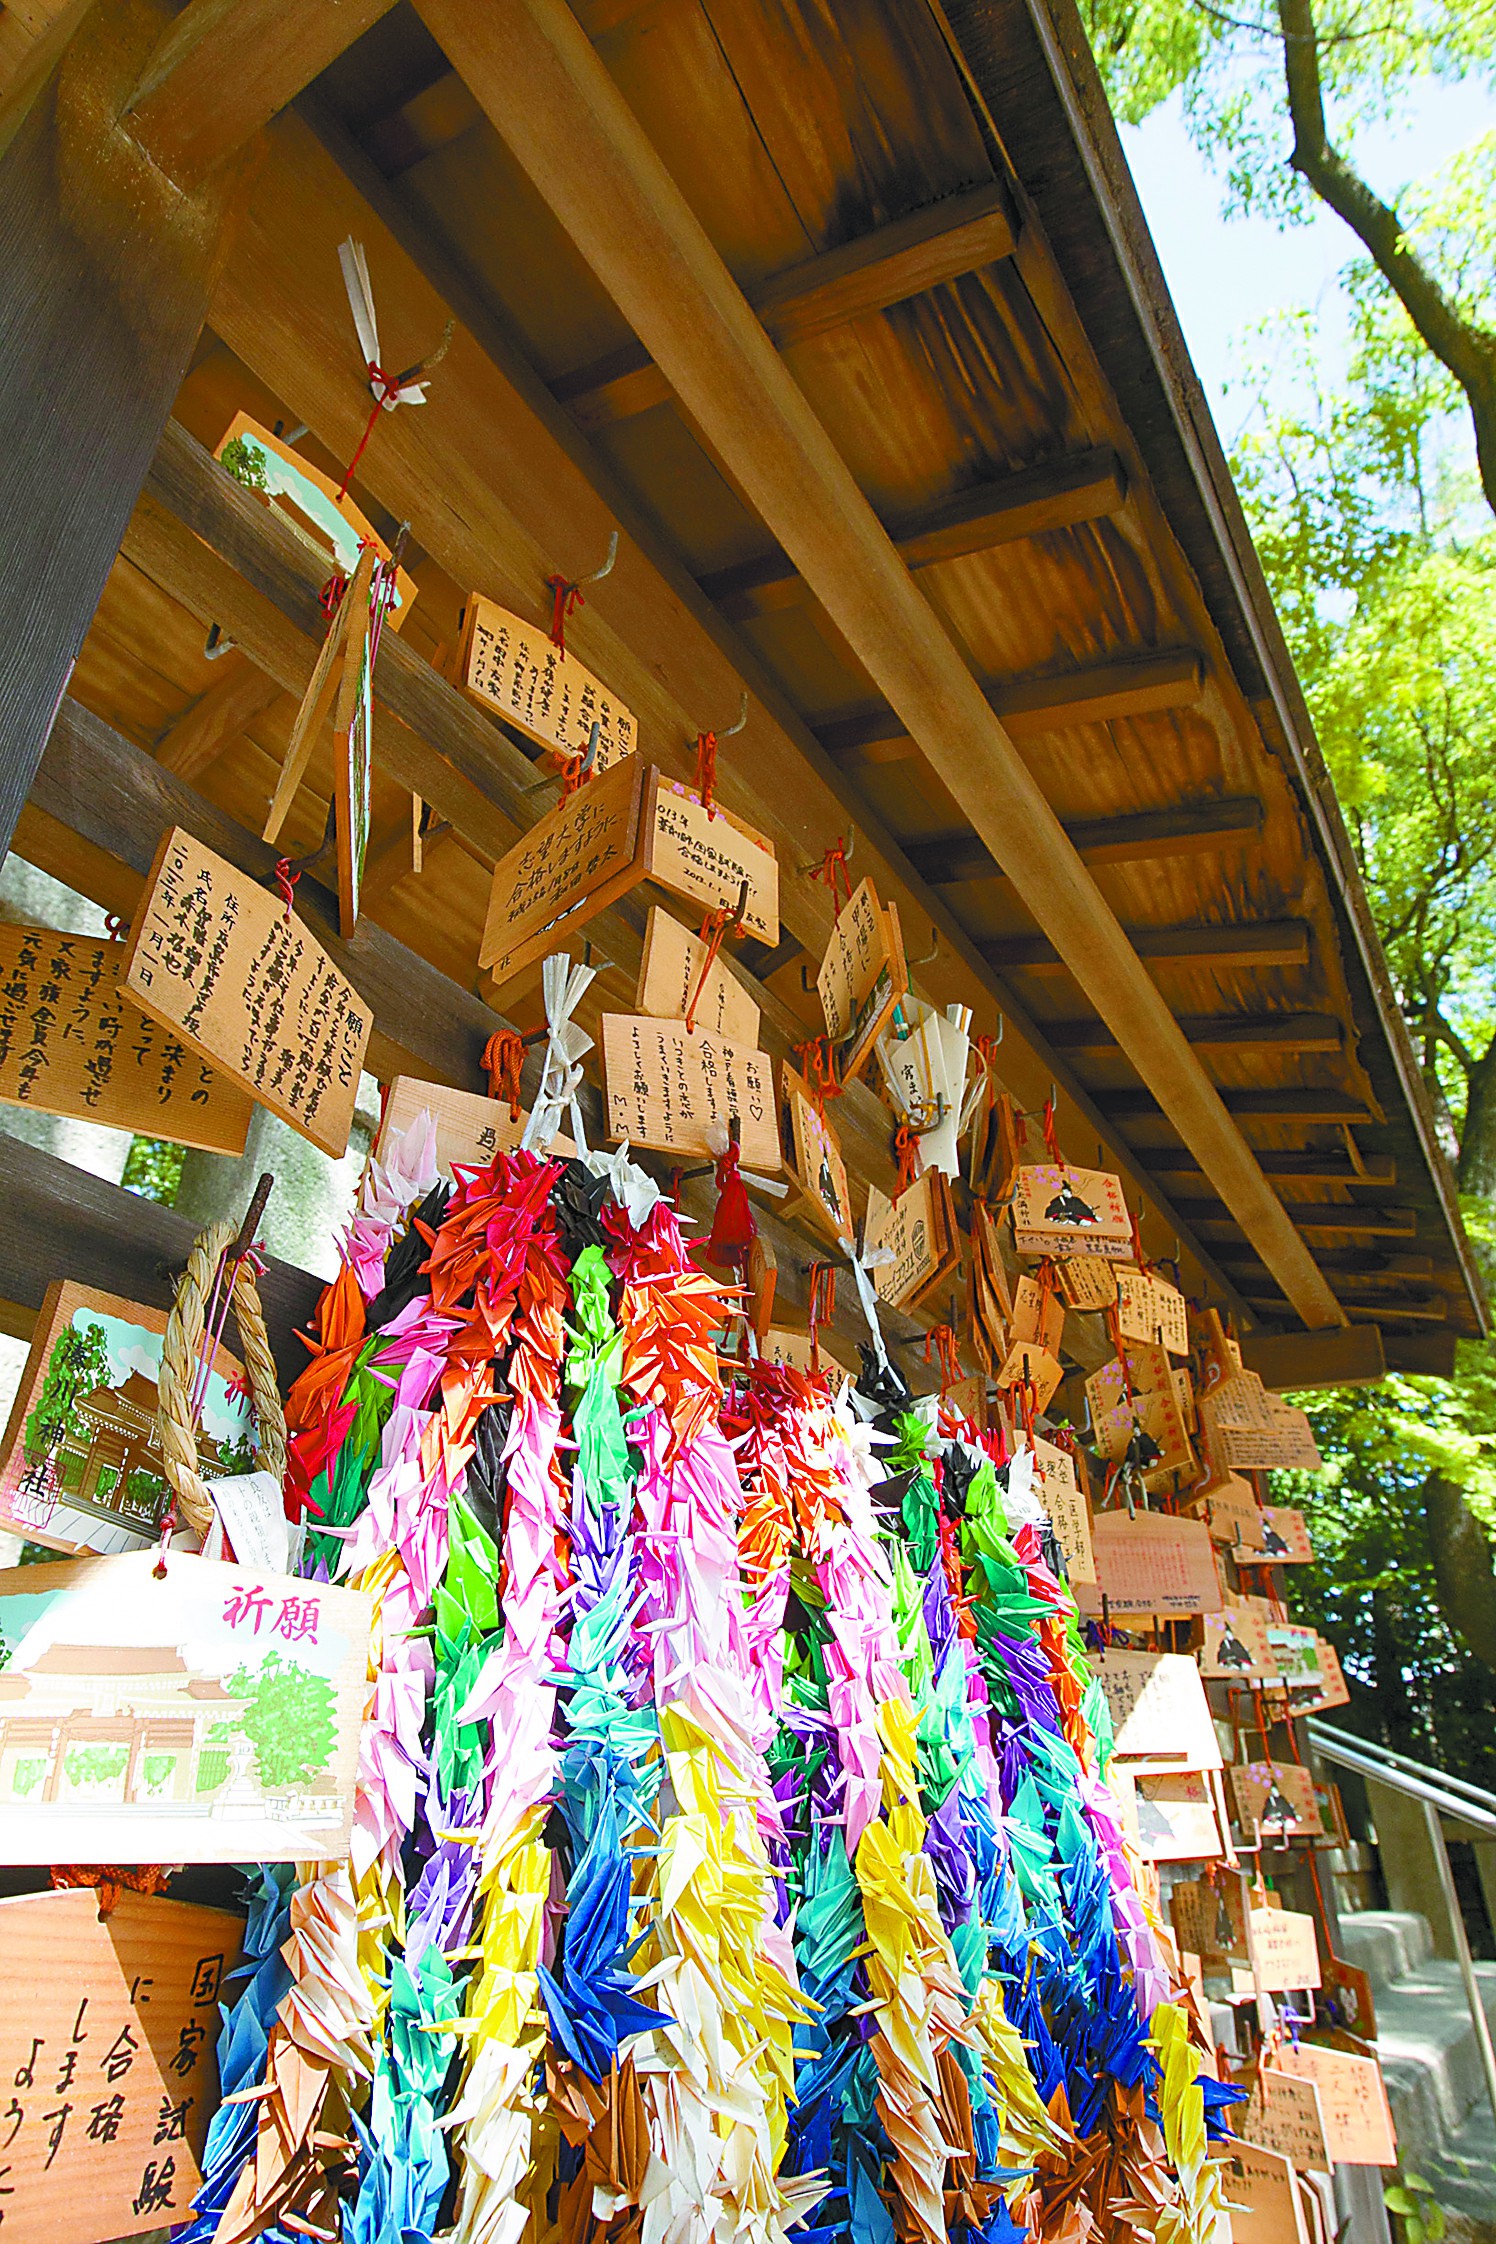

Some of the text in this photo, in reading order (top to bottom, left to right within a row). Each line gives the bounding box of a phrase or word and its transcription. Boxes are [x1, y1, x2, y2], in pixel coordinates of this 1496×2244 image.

[657, 804, 689, 829] 013年
[191, 868, 213, 906] 氏名
[219, 892, 240, 932] 住所
[139, 912, 170, 987] 一月一日
[337, 1008, 364, 1088] 願いごと
[222, 1585, 321, 1646] 祈願
[43, 1998, 89, 2171] します
[132, 1954, 224, 2216] 国家試験
